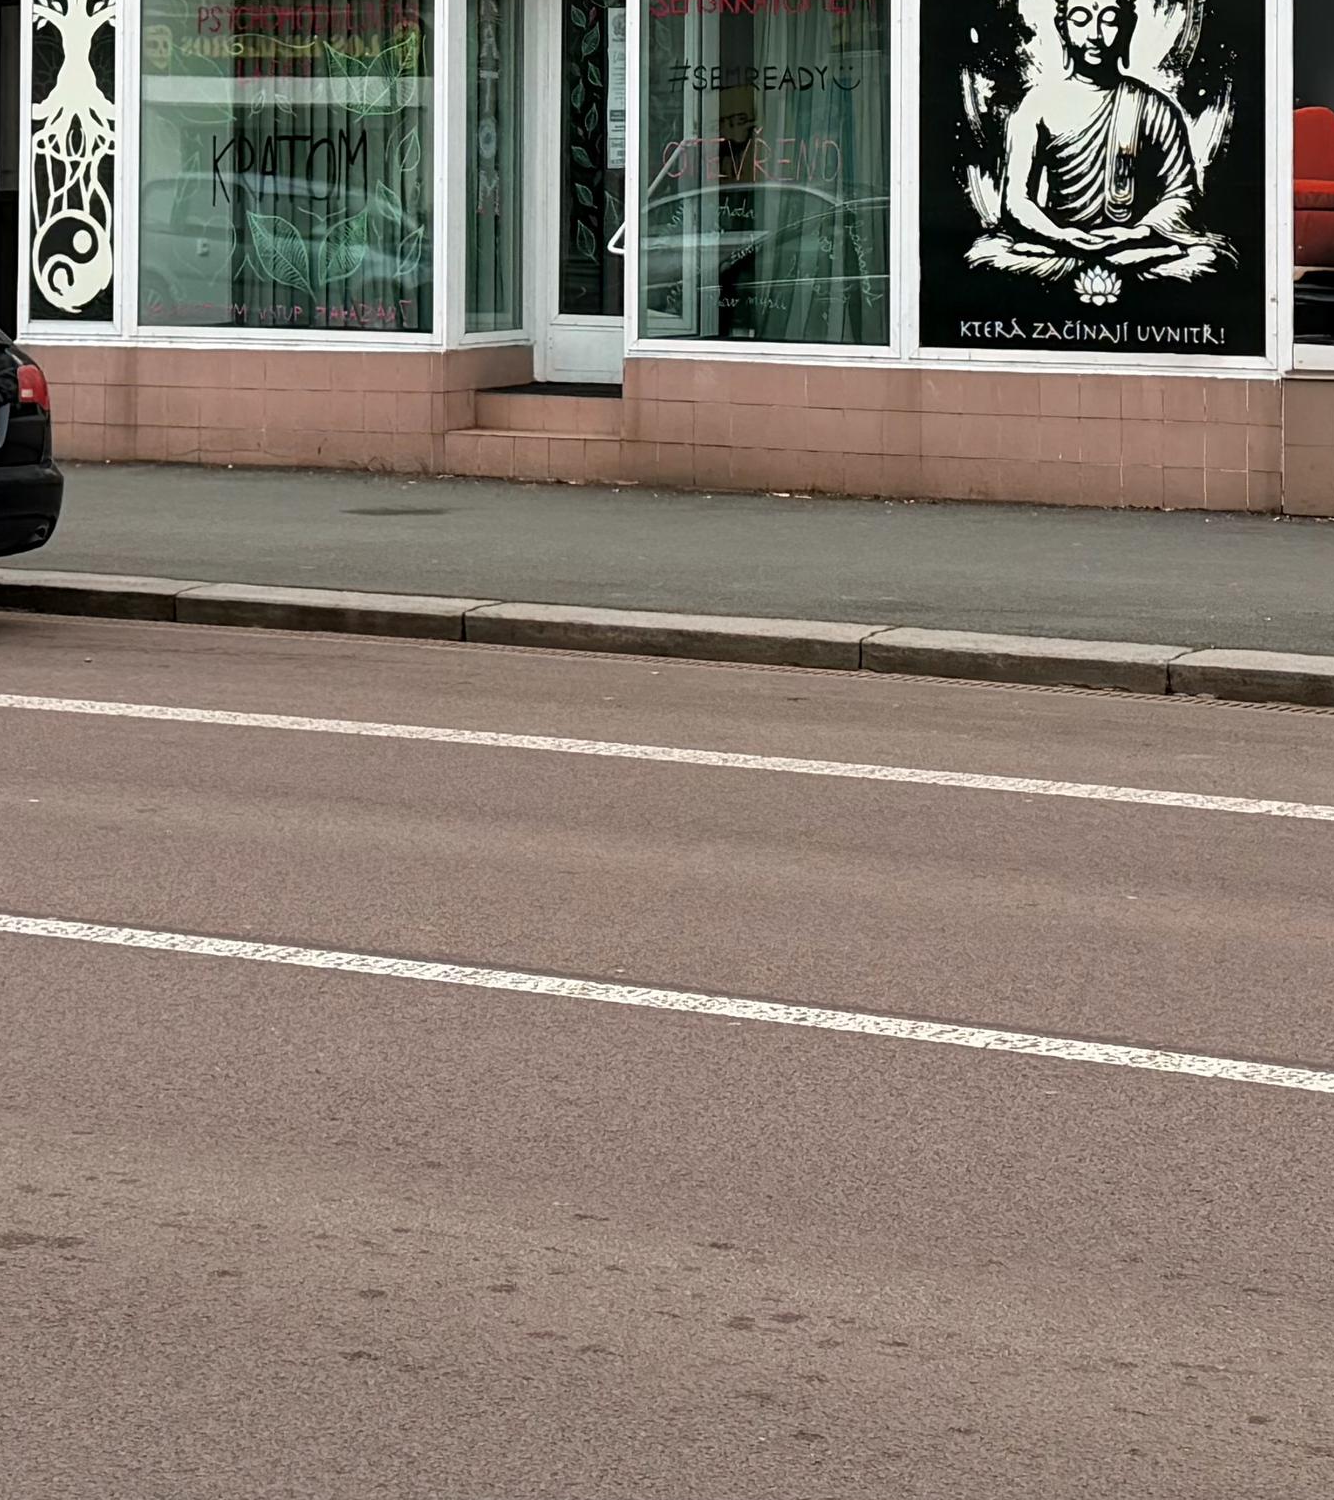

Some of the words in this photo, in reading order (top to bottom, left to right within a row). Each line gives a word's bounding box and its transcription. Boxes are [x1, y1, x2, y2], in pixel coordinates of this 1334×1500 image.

[212, 129, 368, 207] KRATOM
[960, 318, 1026, 339] KTERÁ
[1032, 320, 1129, 344] ZAČÍNAJÍ
[1137, 324, 1225, 345] UVNITŘ!
